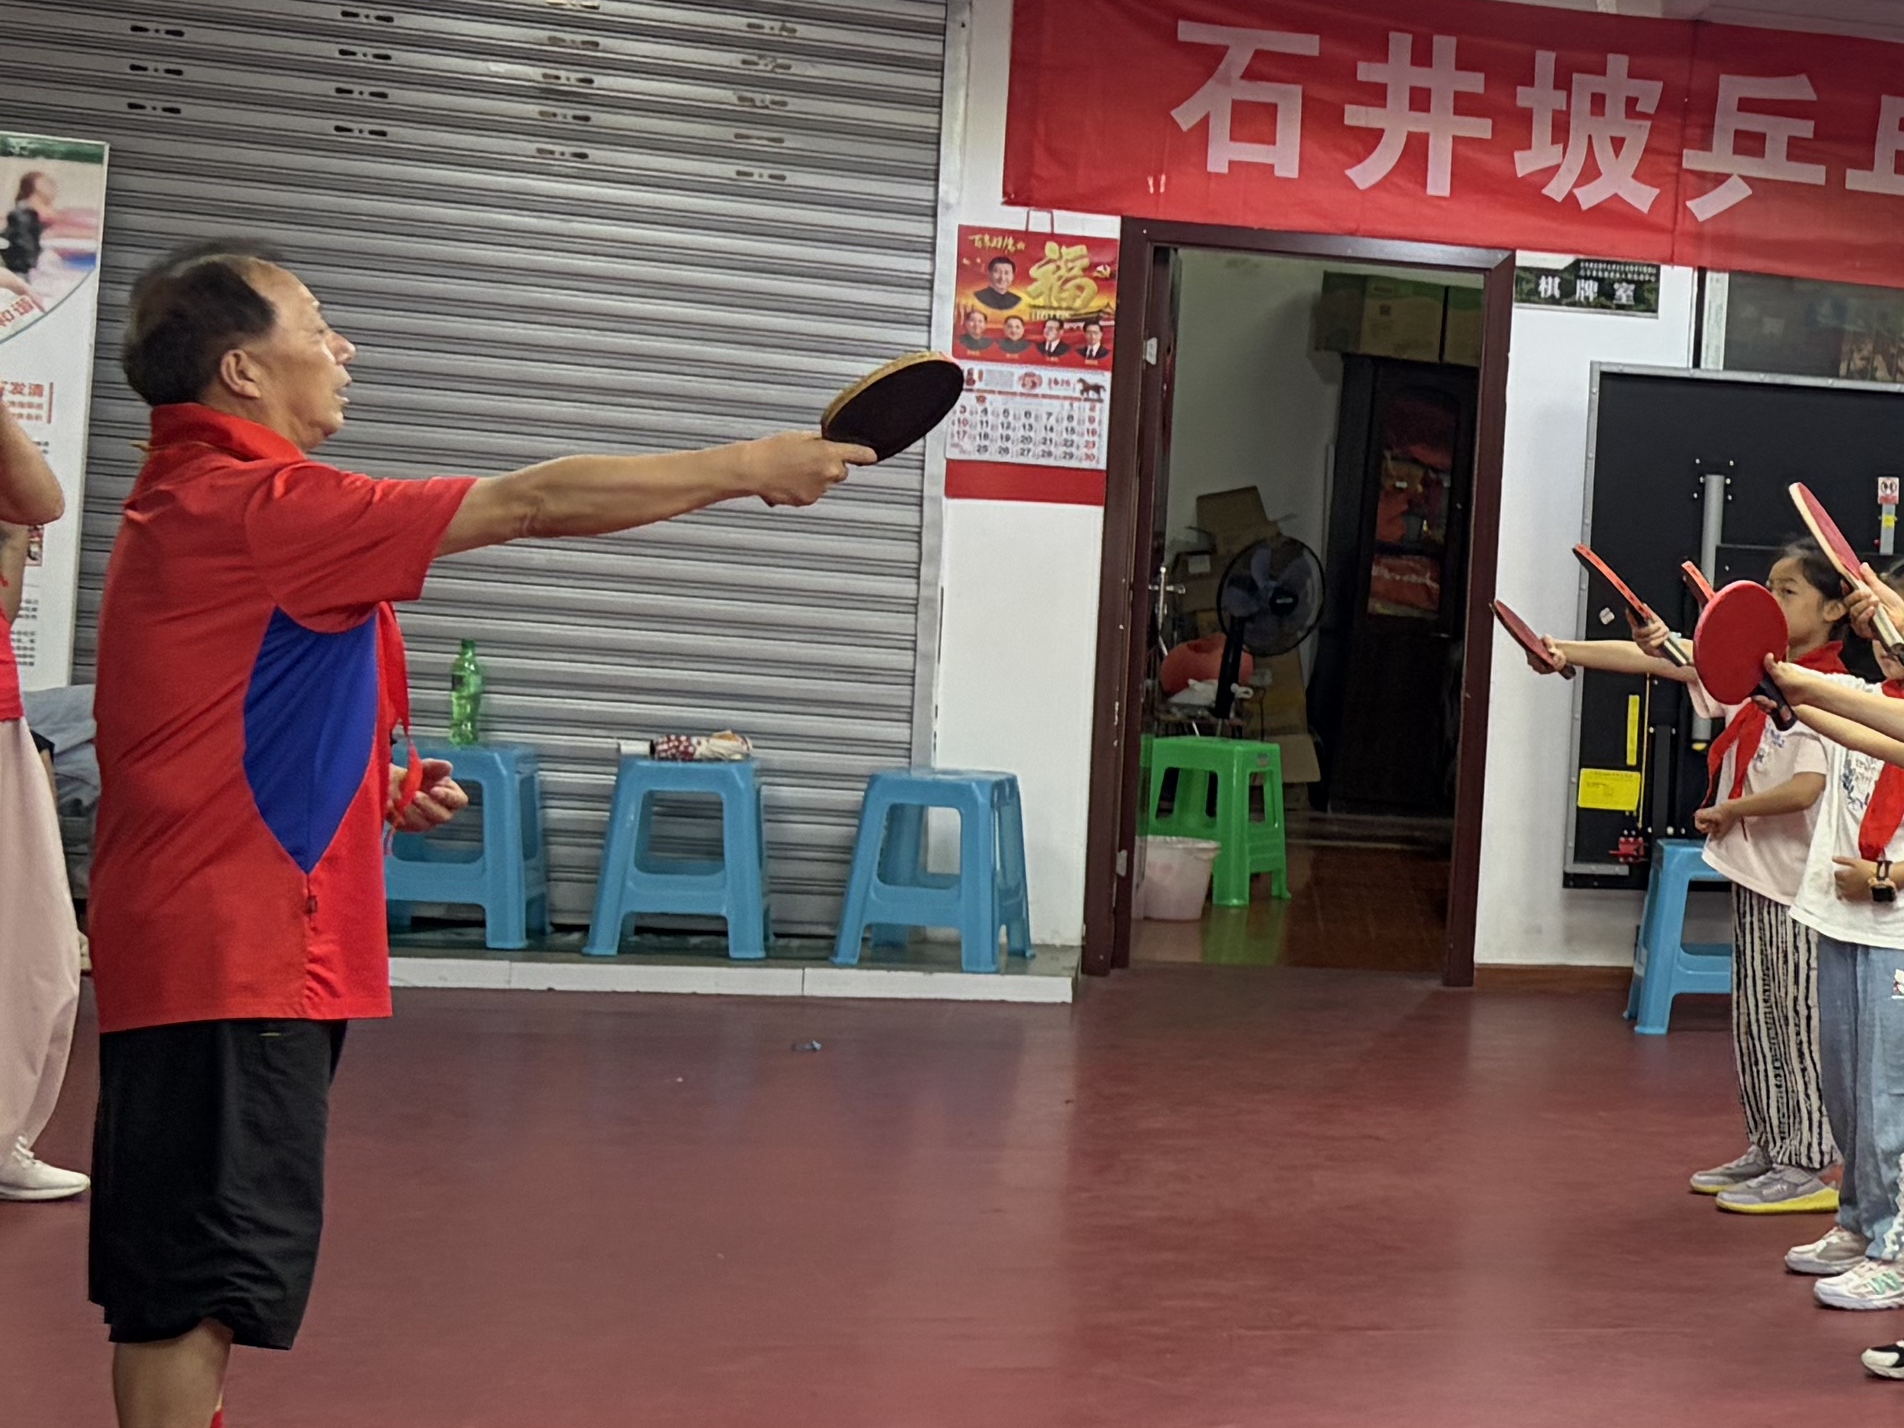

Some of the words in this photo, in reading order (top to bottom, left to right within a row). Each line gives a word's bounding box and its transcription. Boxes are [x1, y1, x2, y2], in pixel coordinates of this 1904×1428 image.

[1027, 241, 1098, 308] 福
[1538, 274, 1636, 305] 棋牌室
